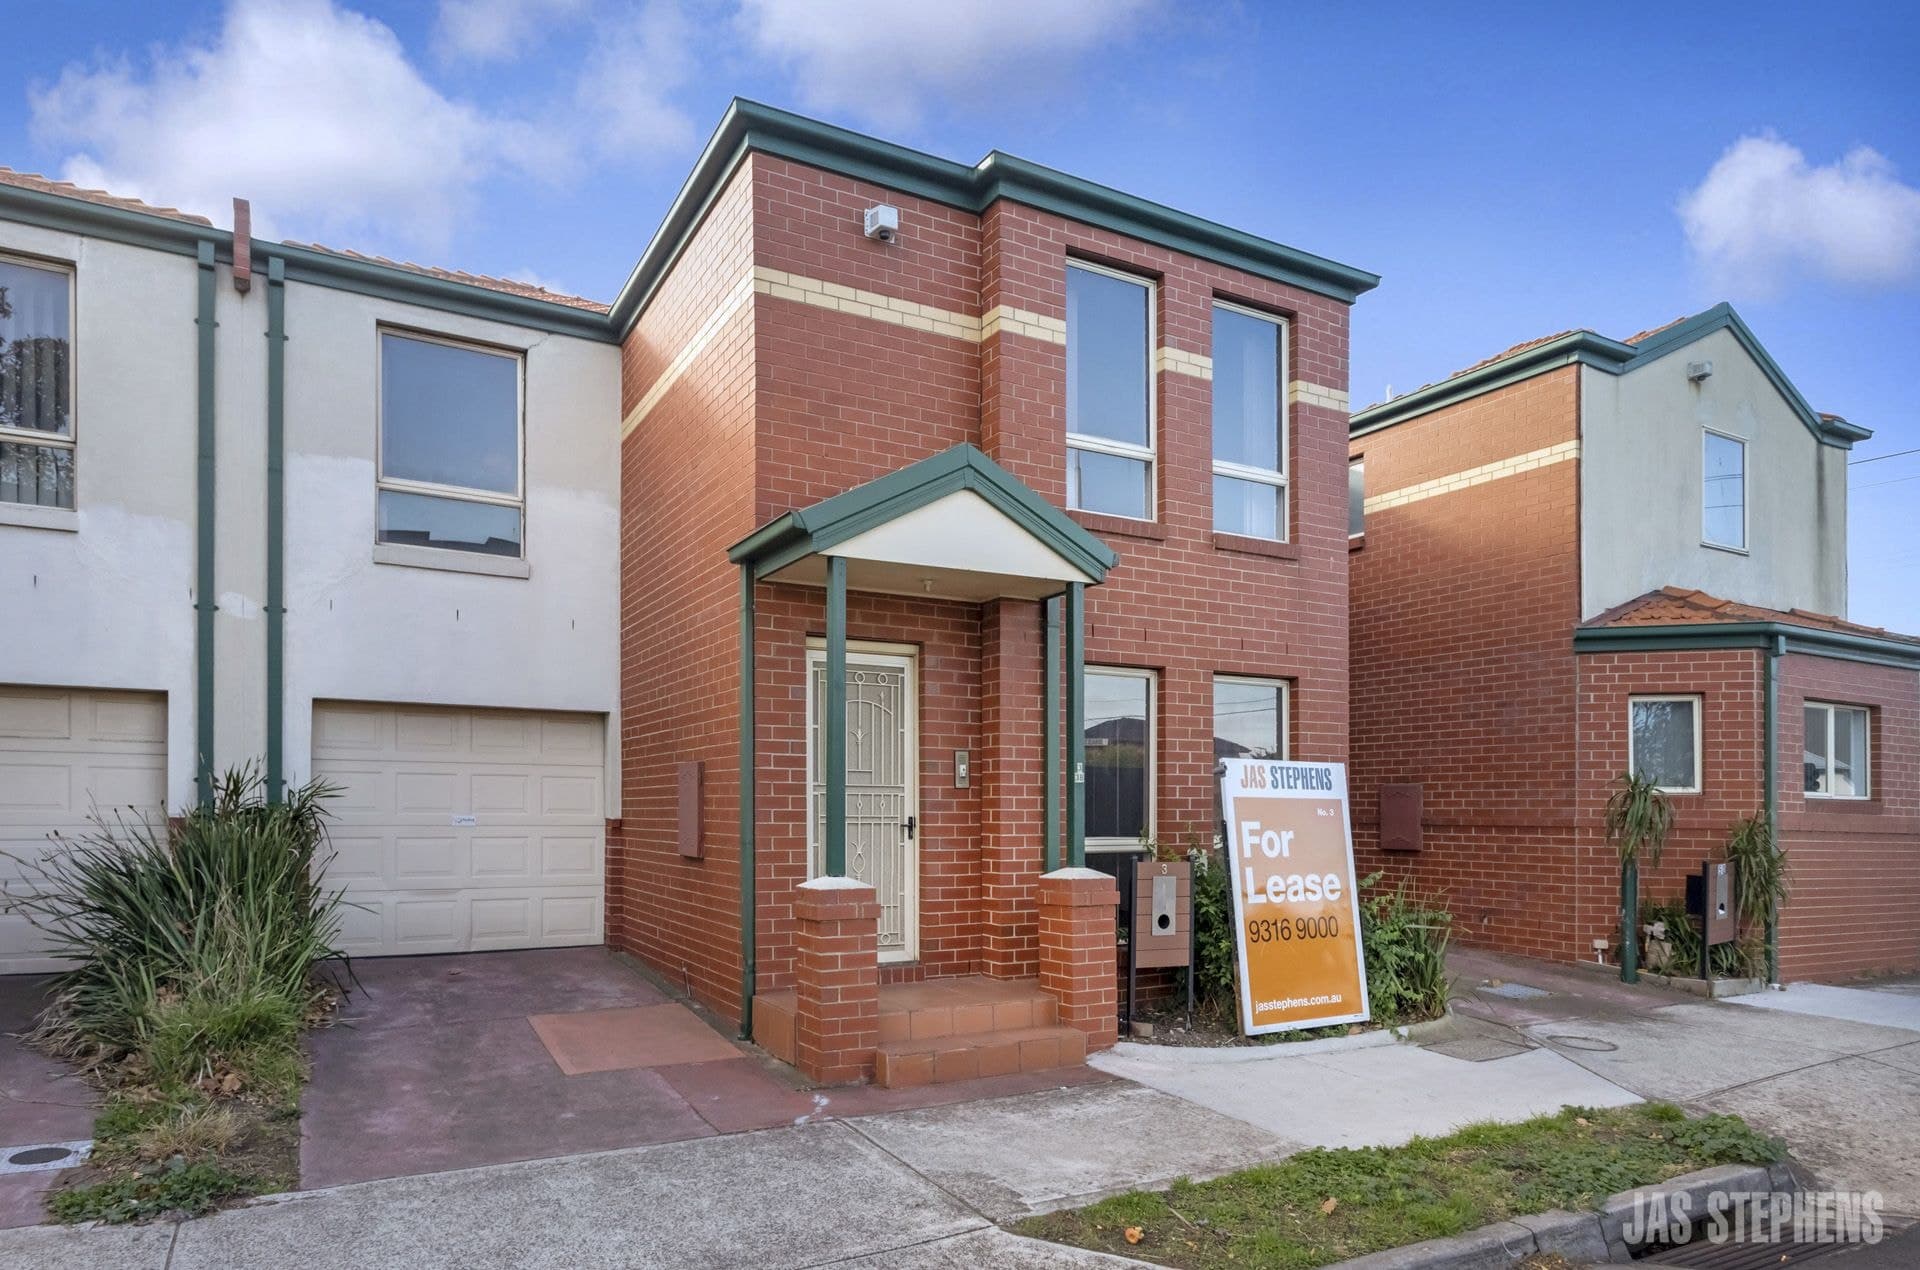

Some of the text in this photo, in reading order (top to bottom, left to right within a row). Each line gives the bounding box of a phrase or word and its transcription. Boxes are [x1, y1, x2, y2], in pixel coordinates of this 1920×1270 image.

[1240, 764, 1332, 791] JAS STEPHENS
[1317, 808, 1335, 816] No. 3
[1241, 821, 1294, 858] For
[1245, 867, 1341, 904] Lease
[1249, 916, 1339, 942] 9316 9000
[1255, 993, 1342, 1014] jasstephens.com.au
